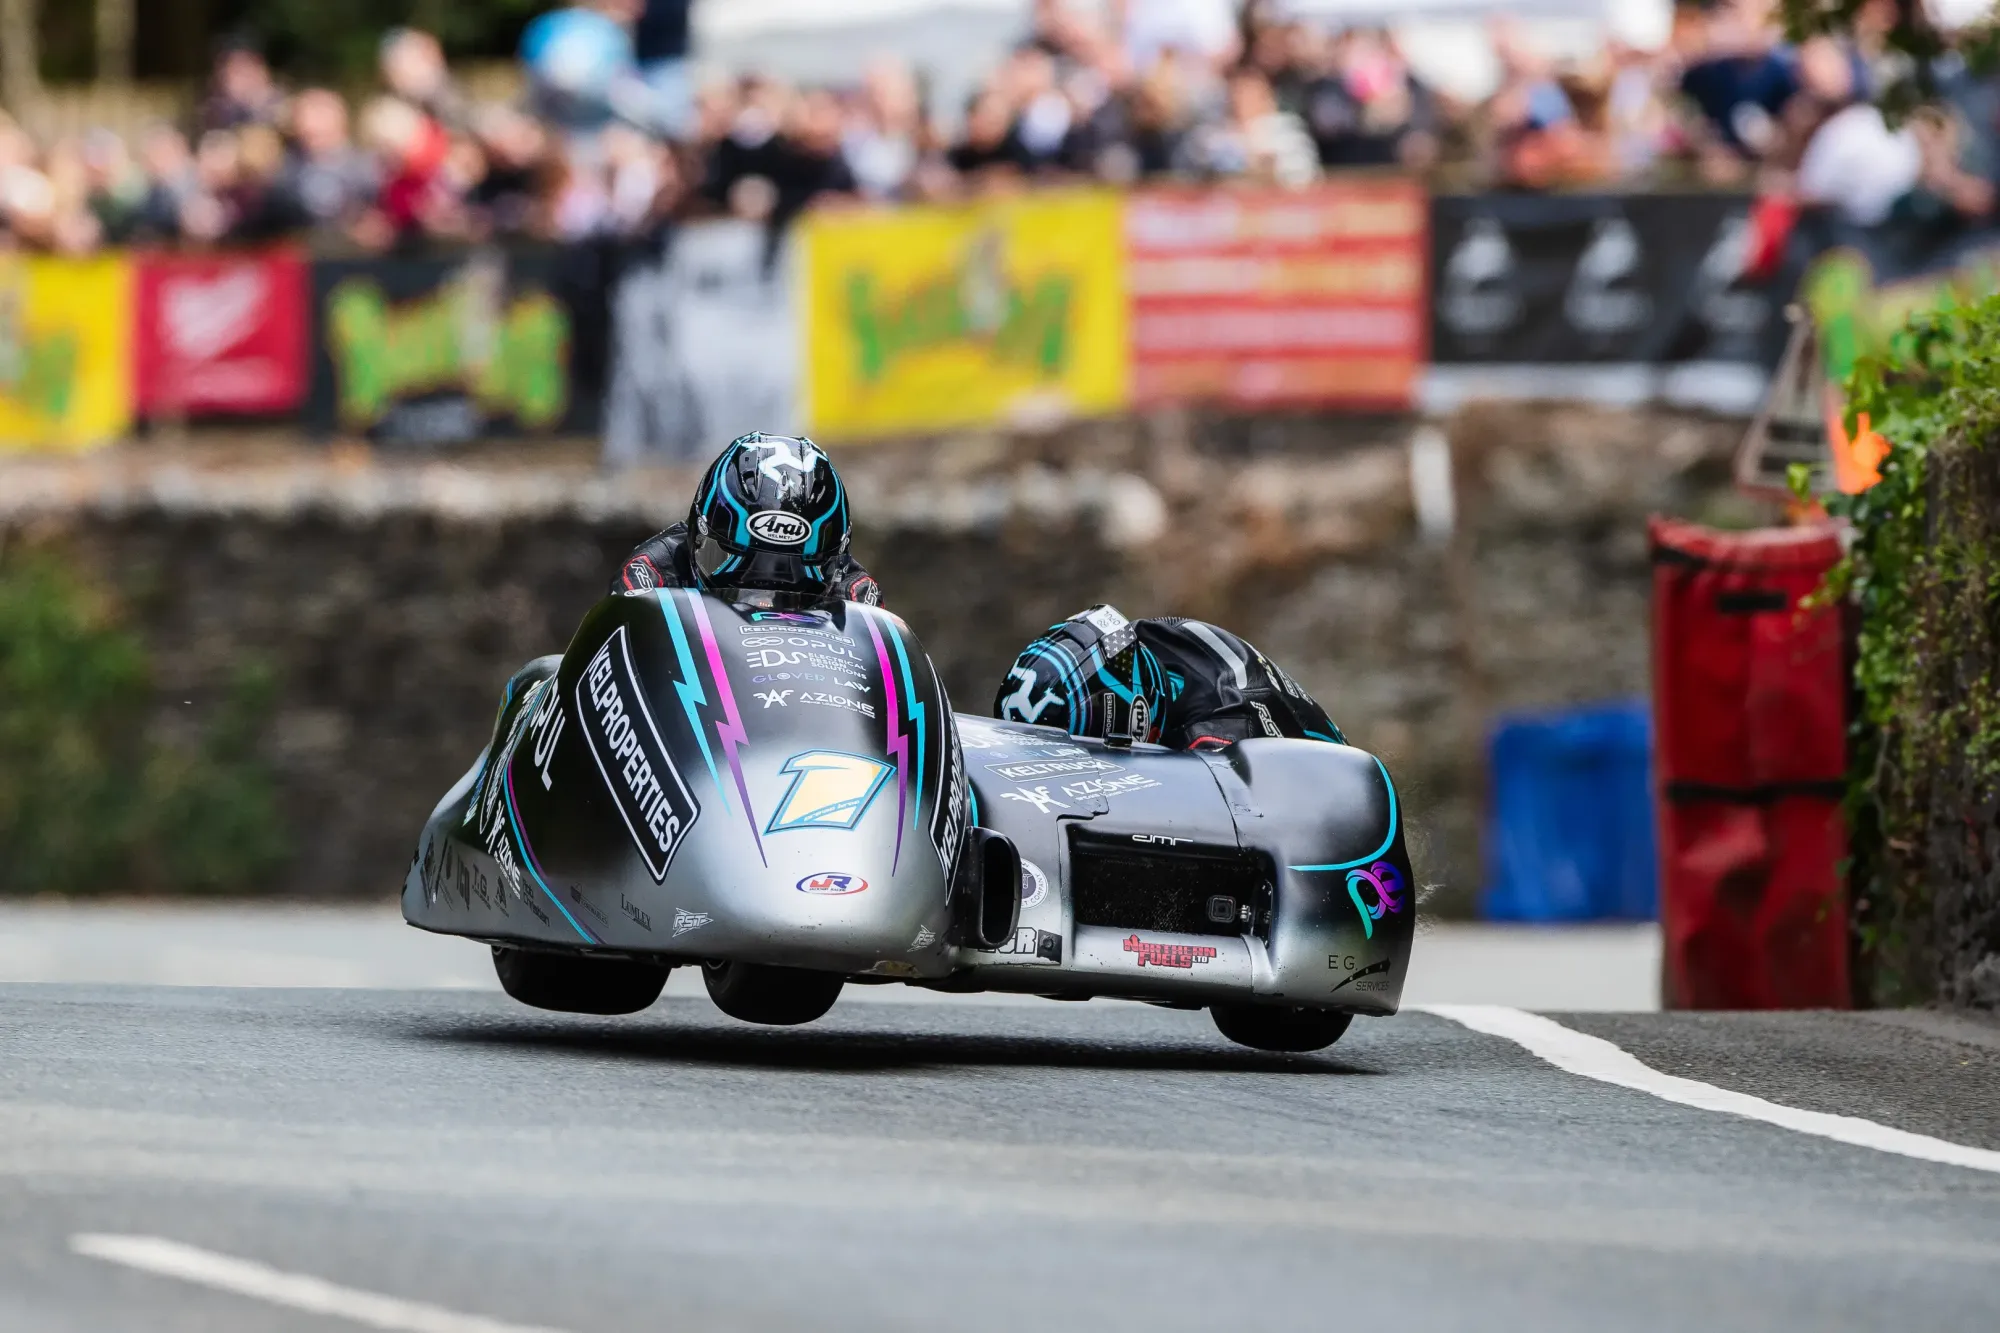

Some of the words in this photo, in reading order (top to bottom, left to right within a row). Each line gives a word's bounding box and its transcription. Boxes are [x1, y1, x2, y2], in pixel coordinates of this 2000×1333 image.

[753, 516, 803, 536] Arai
[630, 563, 653, 592] RS
[743, 626, 852, 645] KELPROPERTIES
[788, 637, 863, 662] OPUL
[808, 652, 867, 671] ELECTRICAL
[810, 657, 847, 669] DESIGN
[811, 662, 867, 680] SOLUTIONS
[833, 677, 871, 693] LAW
[799, 691, 875, 715] AZIONE
[1105, 694, 1113, 735] ROPERTIES
[1131, 700, 1145, 740] Arai
[1250, 700, 1284, 738] RS
[588, 644, 680, 853] KELPROPERTIES
[997, 759, 1114, 779] KELTRUCK
[1060, 773, 1156, 798] AZIONE
[673, 912, 708, 930] RST
[1122, 934, 1217, 958] NORTHERN
[1137, 951, 1192, 969] FUELS
[1192, 955, 1209, 964] LTD
[1355, 981, 1391, 992] SERVICES
